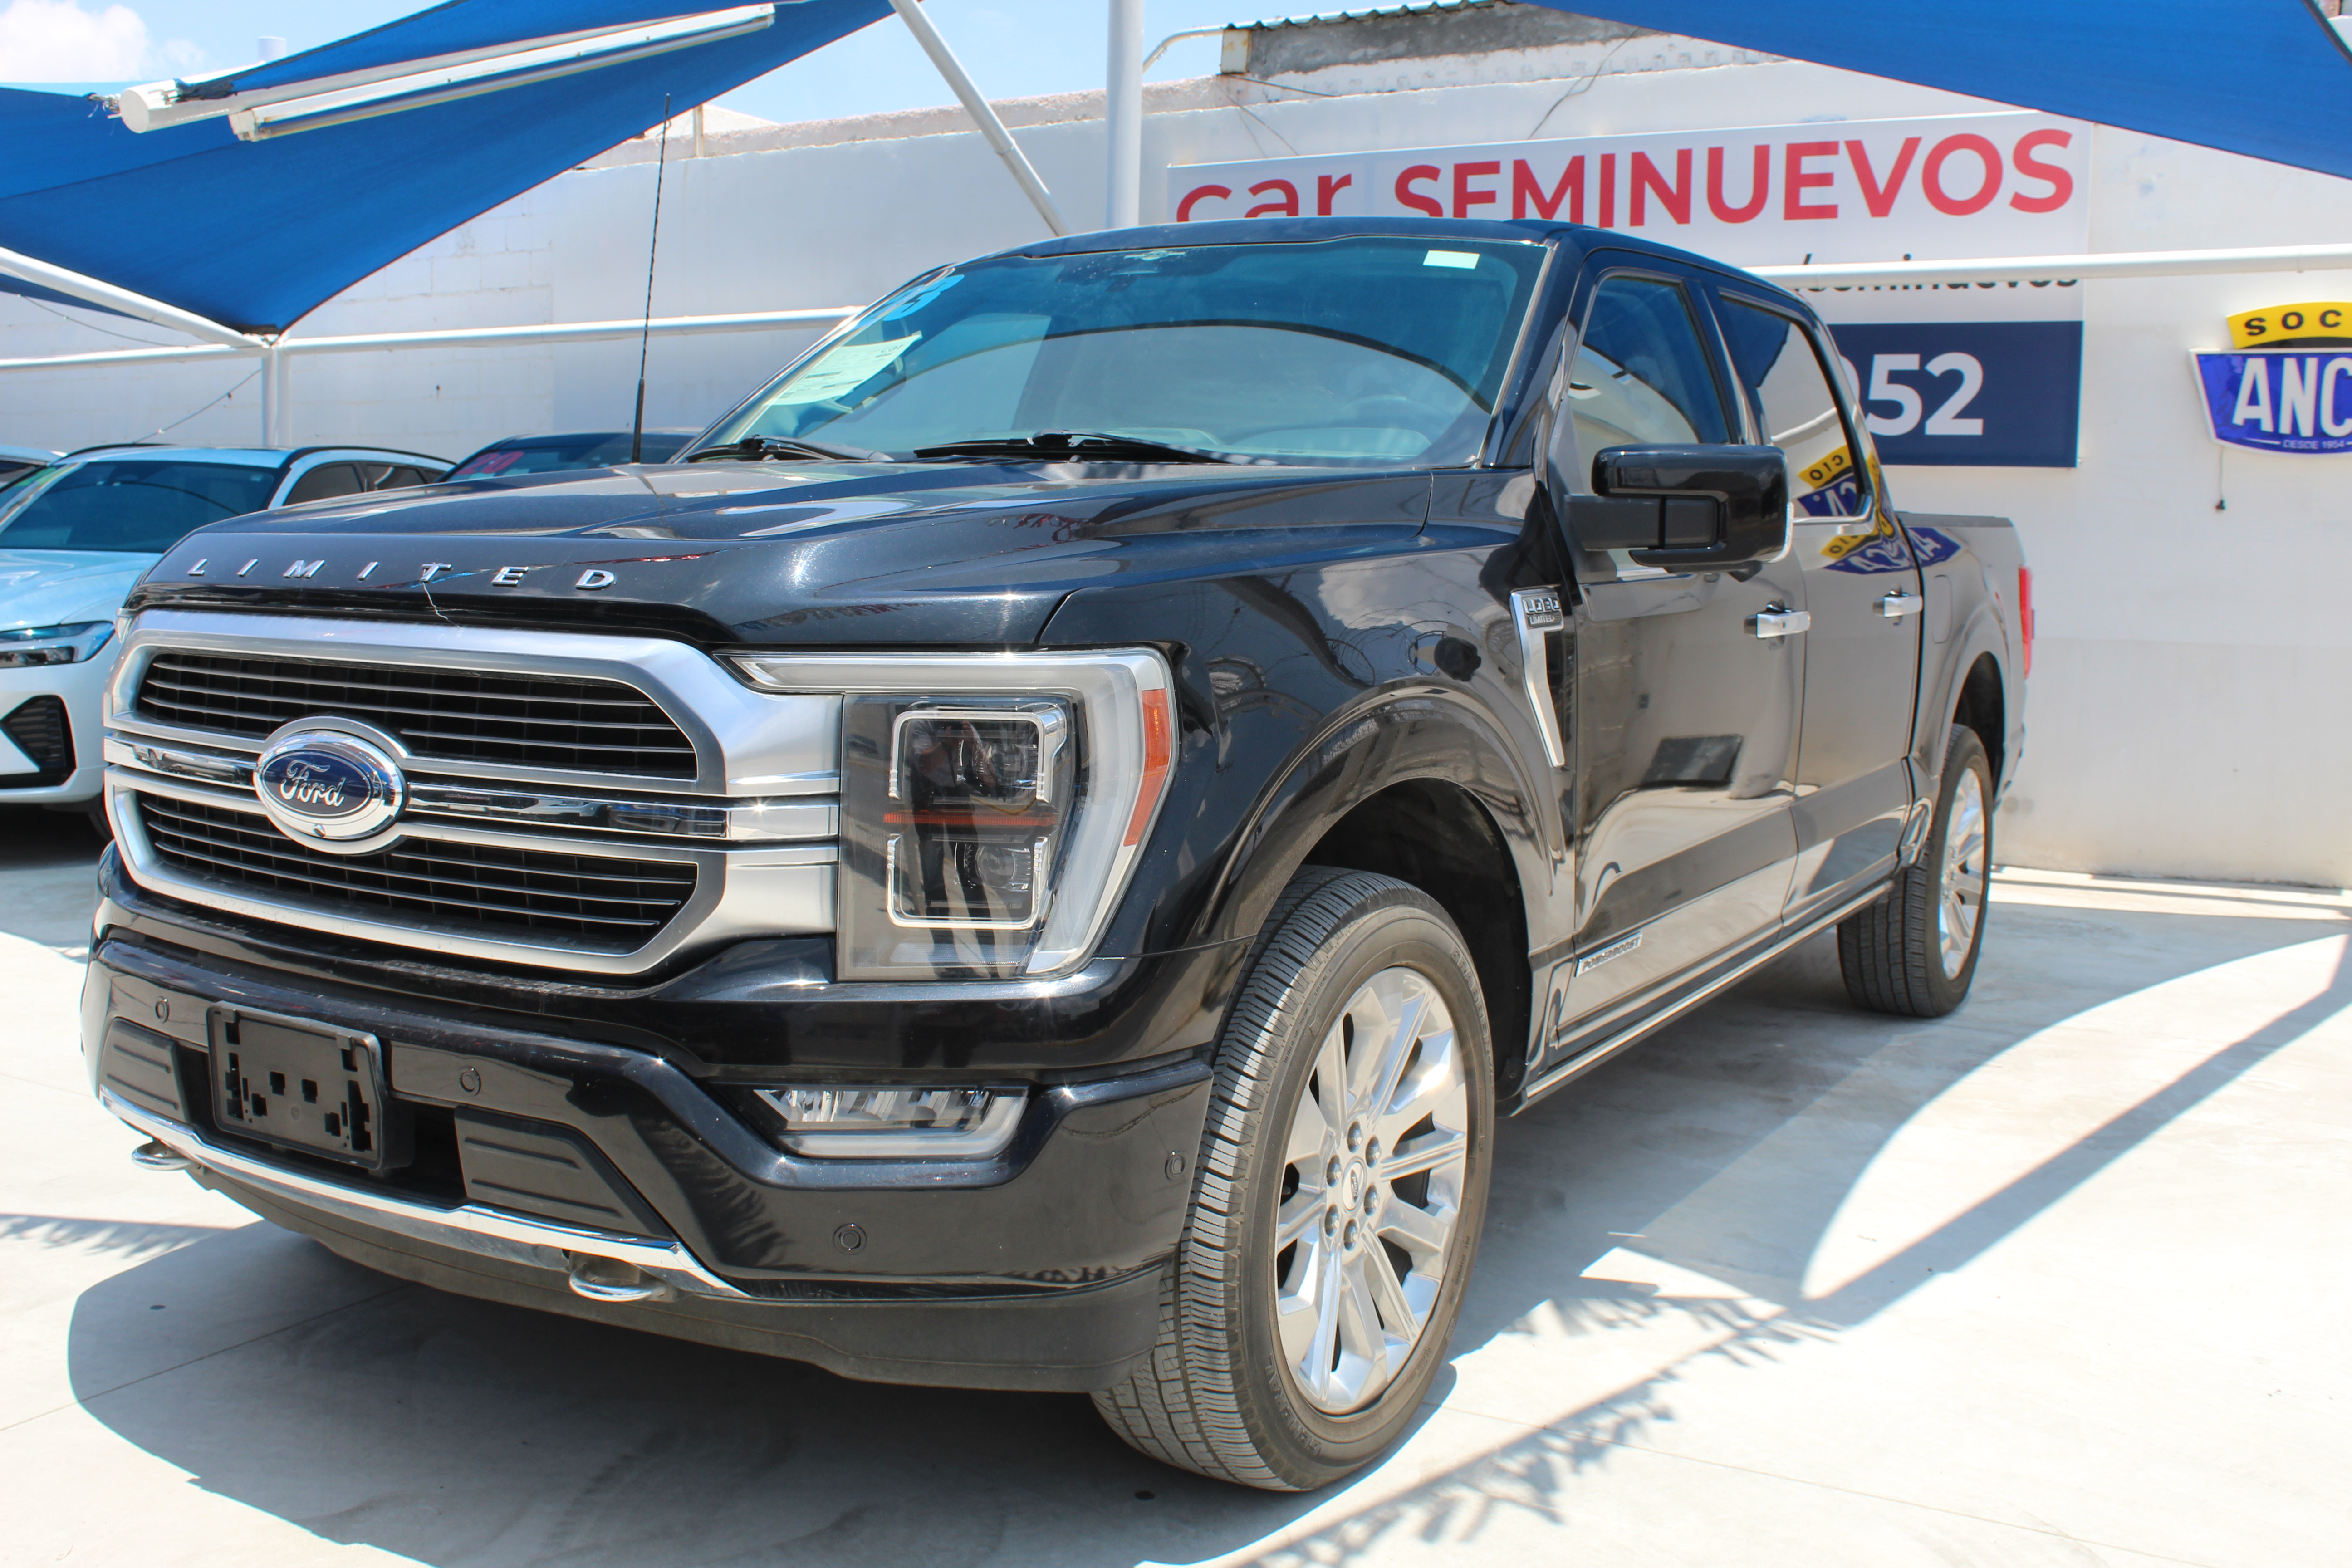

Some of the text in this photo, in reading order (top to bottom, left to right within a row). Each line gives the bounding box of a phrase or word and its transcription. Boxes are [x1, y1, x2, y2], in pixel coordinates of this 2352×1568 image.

[1176, 128, 2075, 229] car SEMINUEVOS
[2244, 309, 2343, 336] SOC
[2232, 357, 2352, 437] ANC
[187, 558, 616, 591] LIMITED
[1522, 597, 1561, 614] LOBO
[279, 759, 347, 807] Ford
